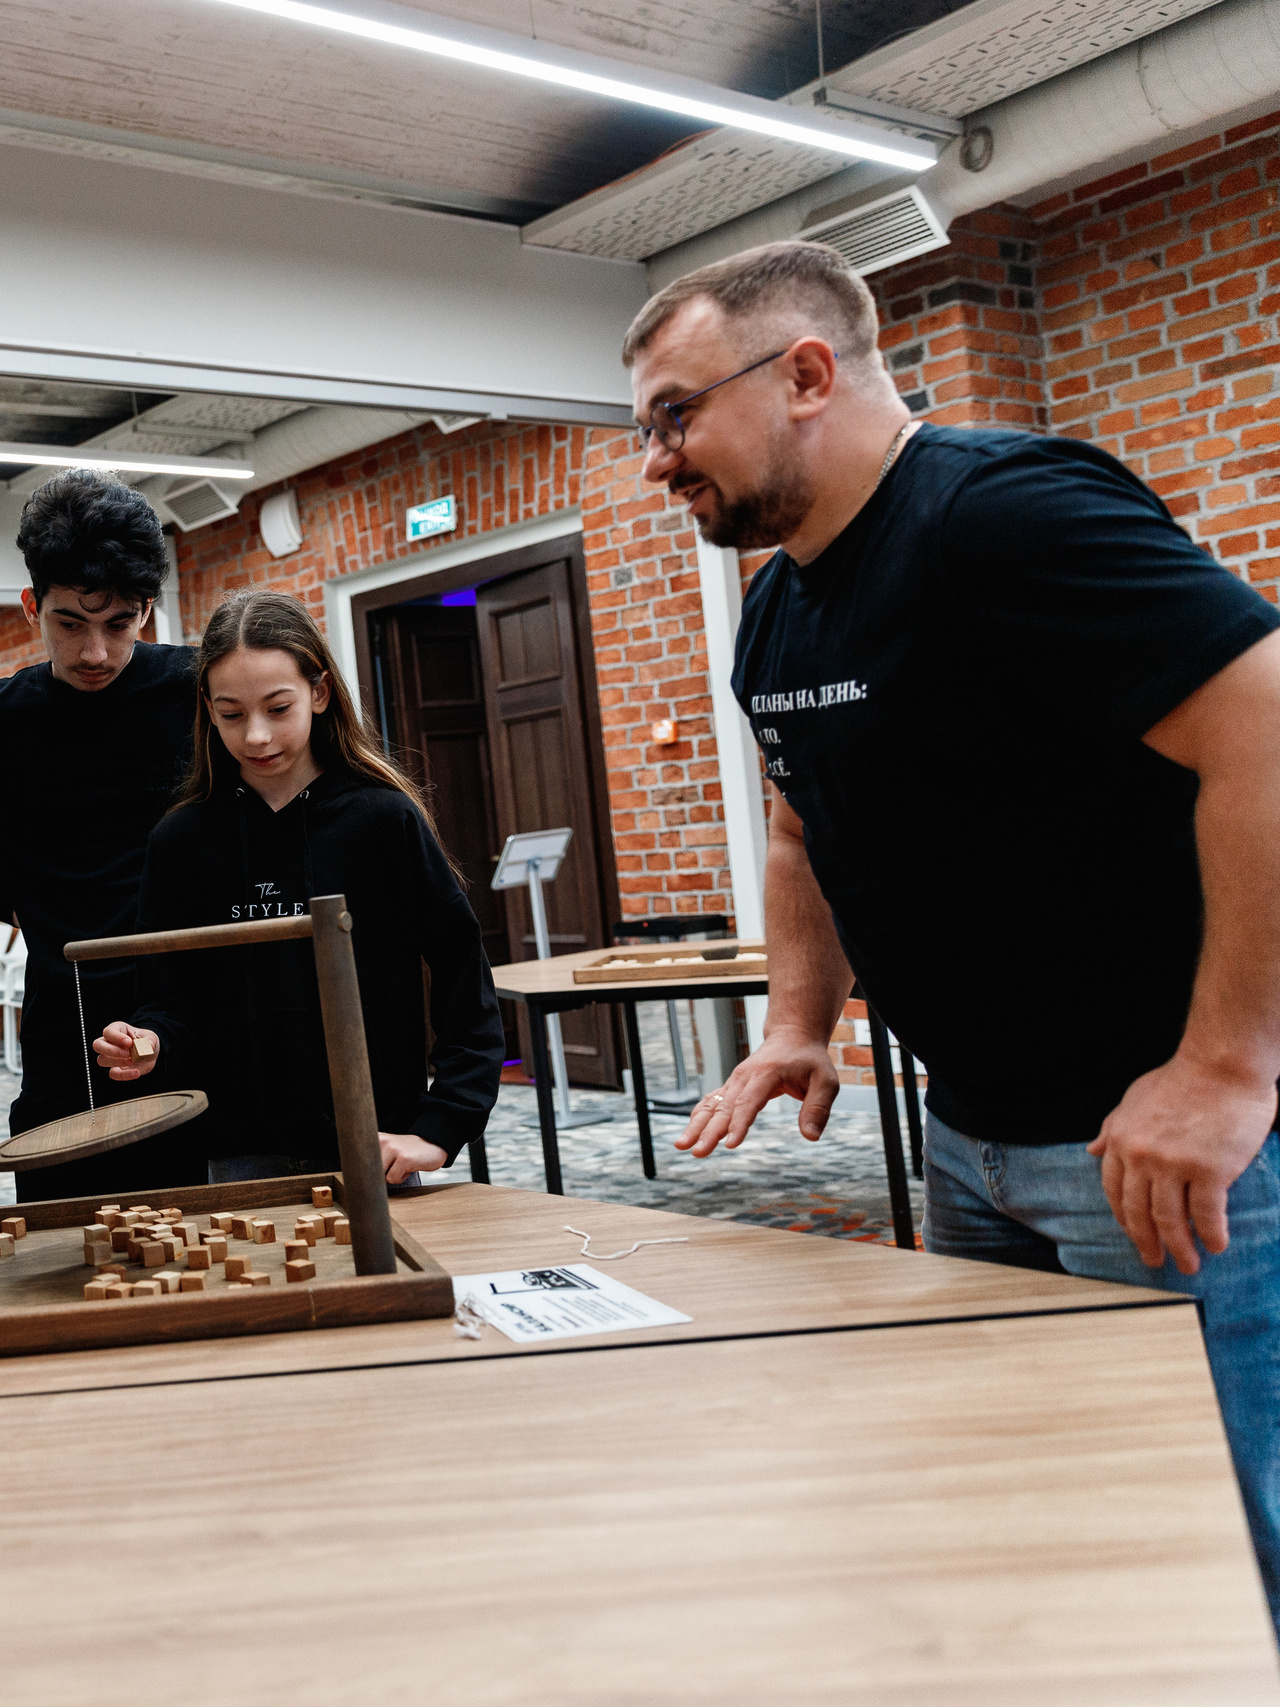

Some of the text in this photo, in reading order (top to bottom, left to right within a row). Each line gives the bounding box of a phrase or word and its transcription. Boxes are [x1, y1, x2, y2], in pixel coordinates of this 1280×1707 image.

[796, 689, 816, 709] НА
[819, 680, 867, 709] ДЕНЬ:
[254, 882, 281, 899] The
[231, 902, 304, 918] STYLE
